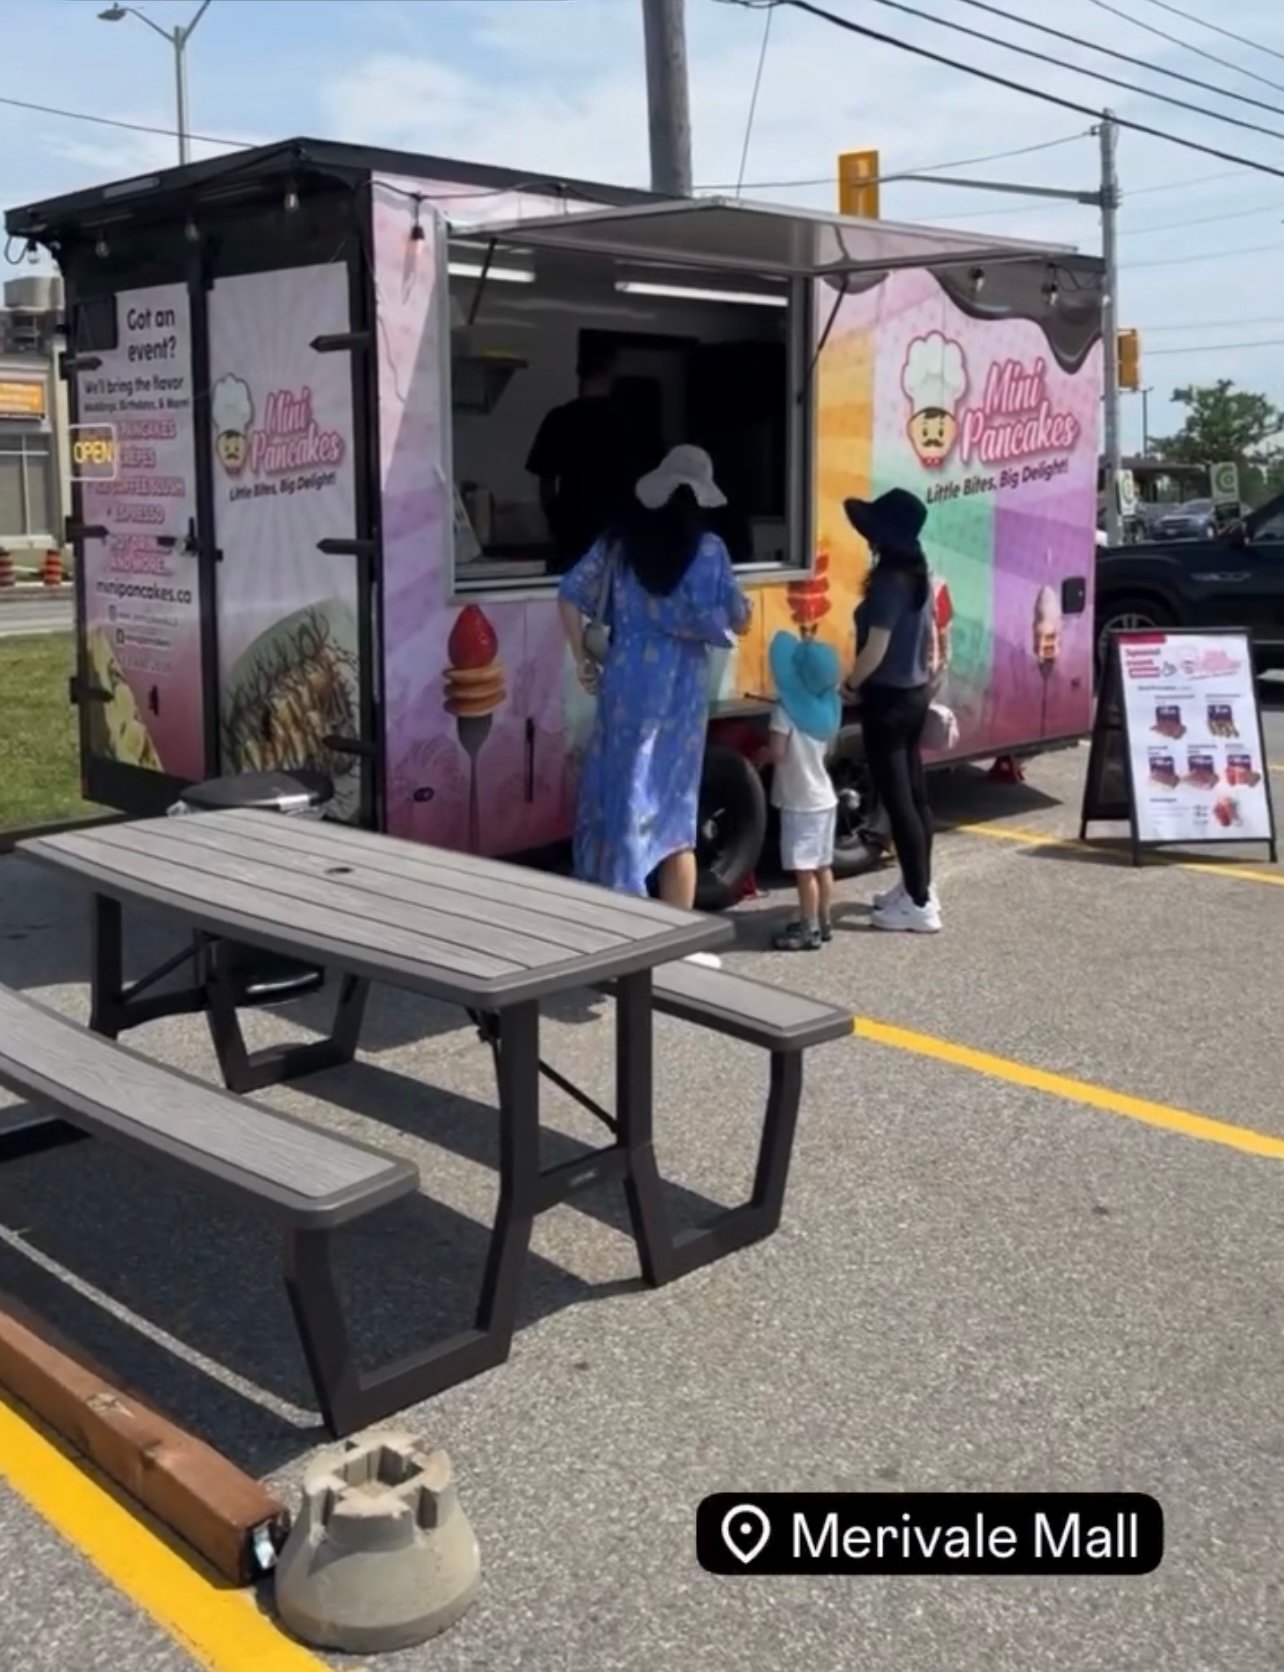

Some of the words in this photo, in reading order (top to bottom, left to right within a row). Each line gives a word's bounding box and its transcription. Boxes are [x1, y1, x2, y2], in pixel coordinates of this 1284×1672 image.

[127, 308, 152, 330] Got
[156, 309, 175, 328] an
[128, 336, 176, 362] event?
[107, 379, 132, 396] bring
[135, 377, 150, 391] the
[153, 375, 184, 391] flavor
[985, 357, 1045, 414] Mini
[266, 388, 310, 433] Mini
[962, 403, 1078, 462] Pancakes
[74, 441, 112, 463] OPEN
[251, 424, 343, 473] Pancakes
[229, 487, 252, 502] Little
[254, 482, 277, 497] Bites,
[280, 479, 295, 495] Big
[297, 471, 336, 490] Delight!
[926, 482, 960, 504] Little
[963, 477, 997, 496] Bites,
[999, 469, 1019, 489] Big
[1022, 459, 1069, 483] Delight!
[96, 580, 192, 604] minipancakes.ca
